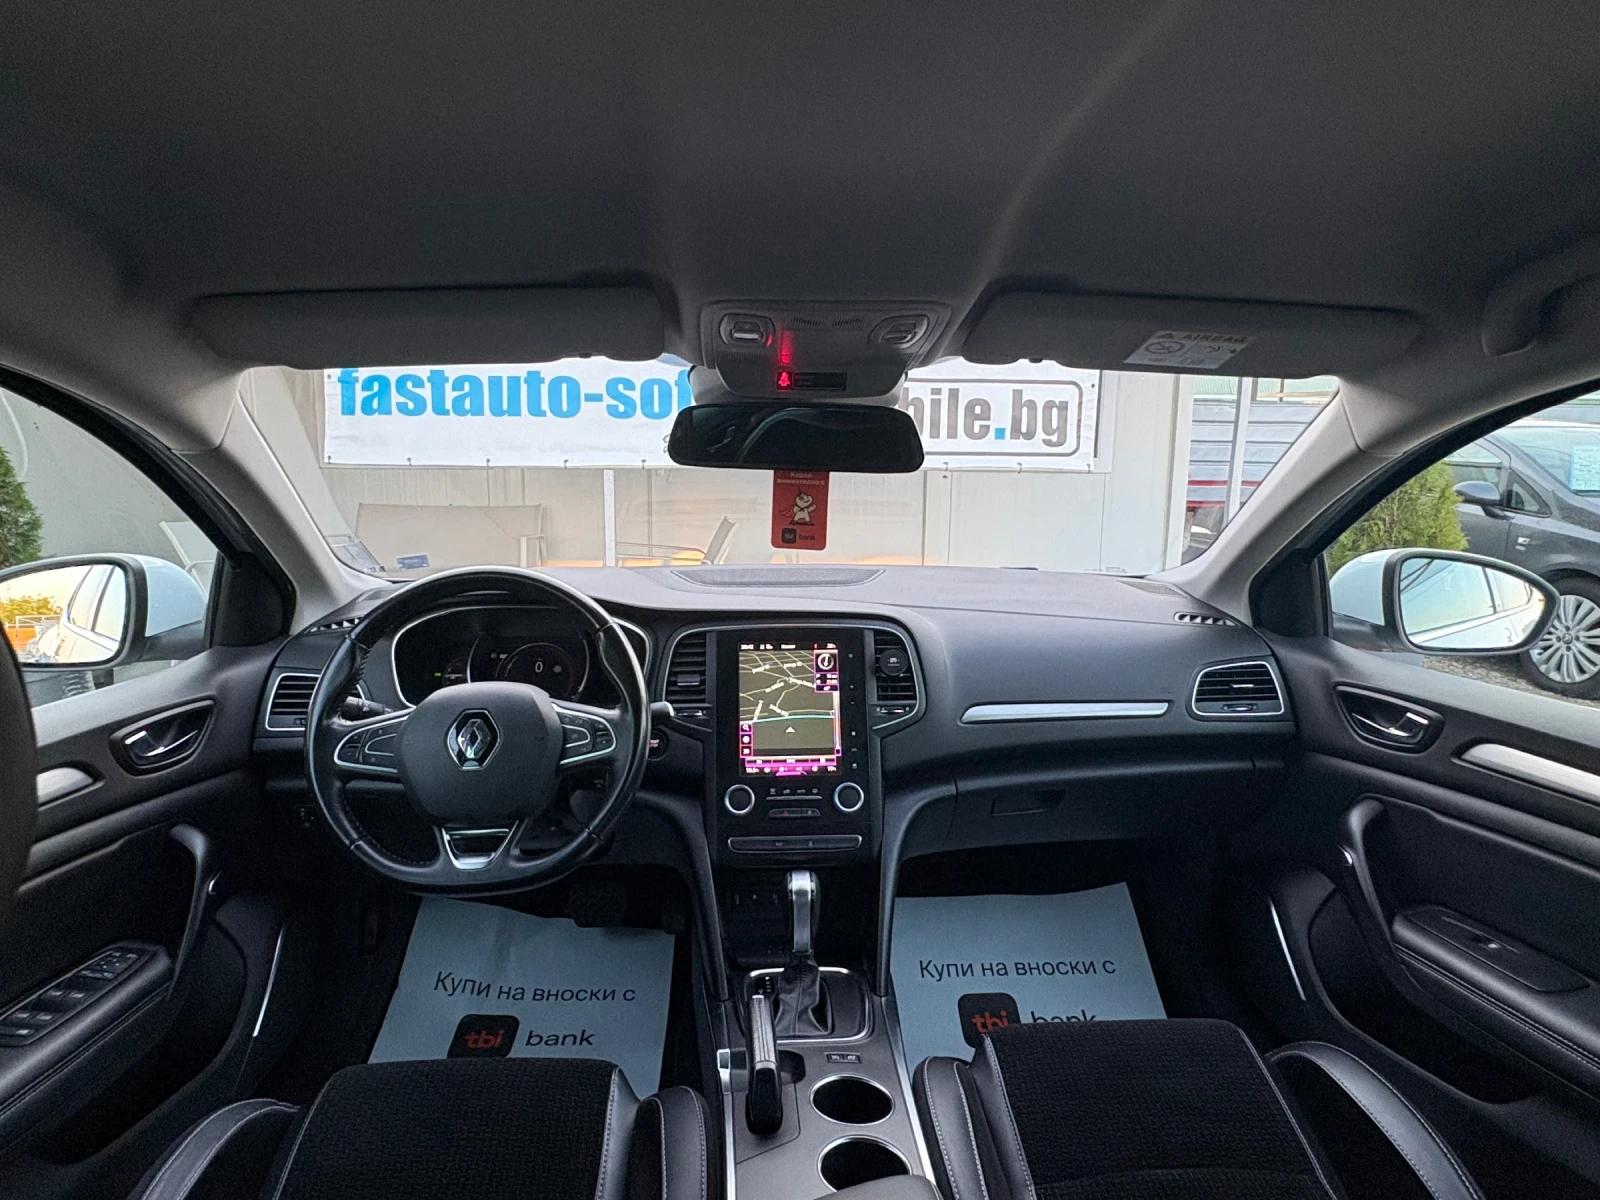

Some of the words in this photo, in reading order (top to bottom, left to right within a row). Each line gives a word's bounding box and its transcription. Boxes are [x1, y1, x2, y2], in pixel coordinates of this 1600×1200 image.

[919, 959, 975, 982] Купи
[981, 962, 1009, 977] на
[1014, 960, 1097, 976] вноски
[1102, 959, 1116, 975] с
[433, 971, 492, 998] Купи
[497, 985, 525, 1001] на
[532, 987, 616, 1002] вноски
[622, 988, 636, 1001] с
[465, 1029, 505, 1049] tbi
[525, 1029, 596, 1047] bank
